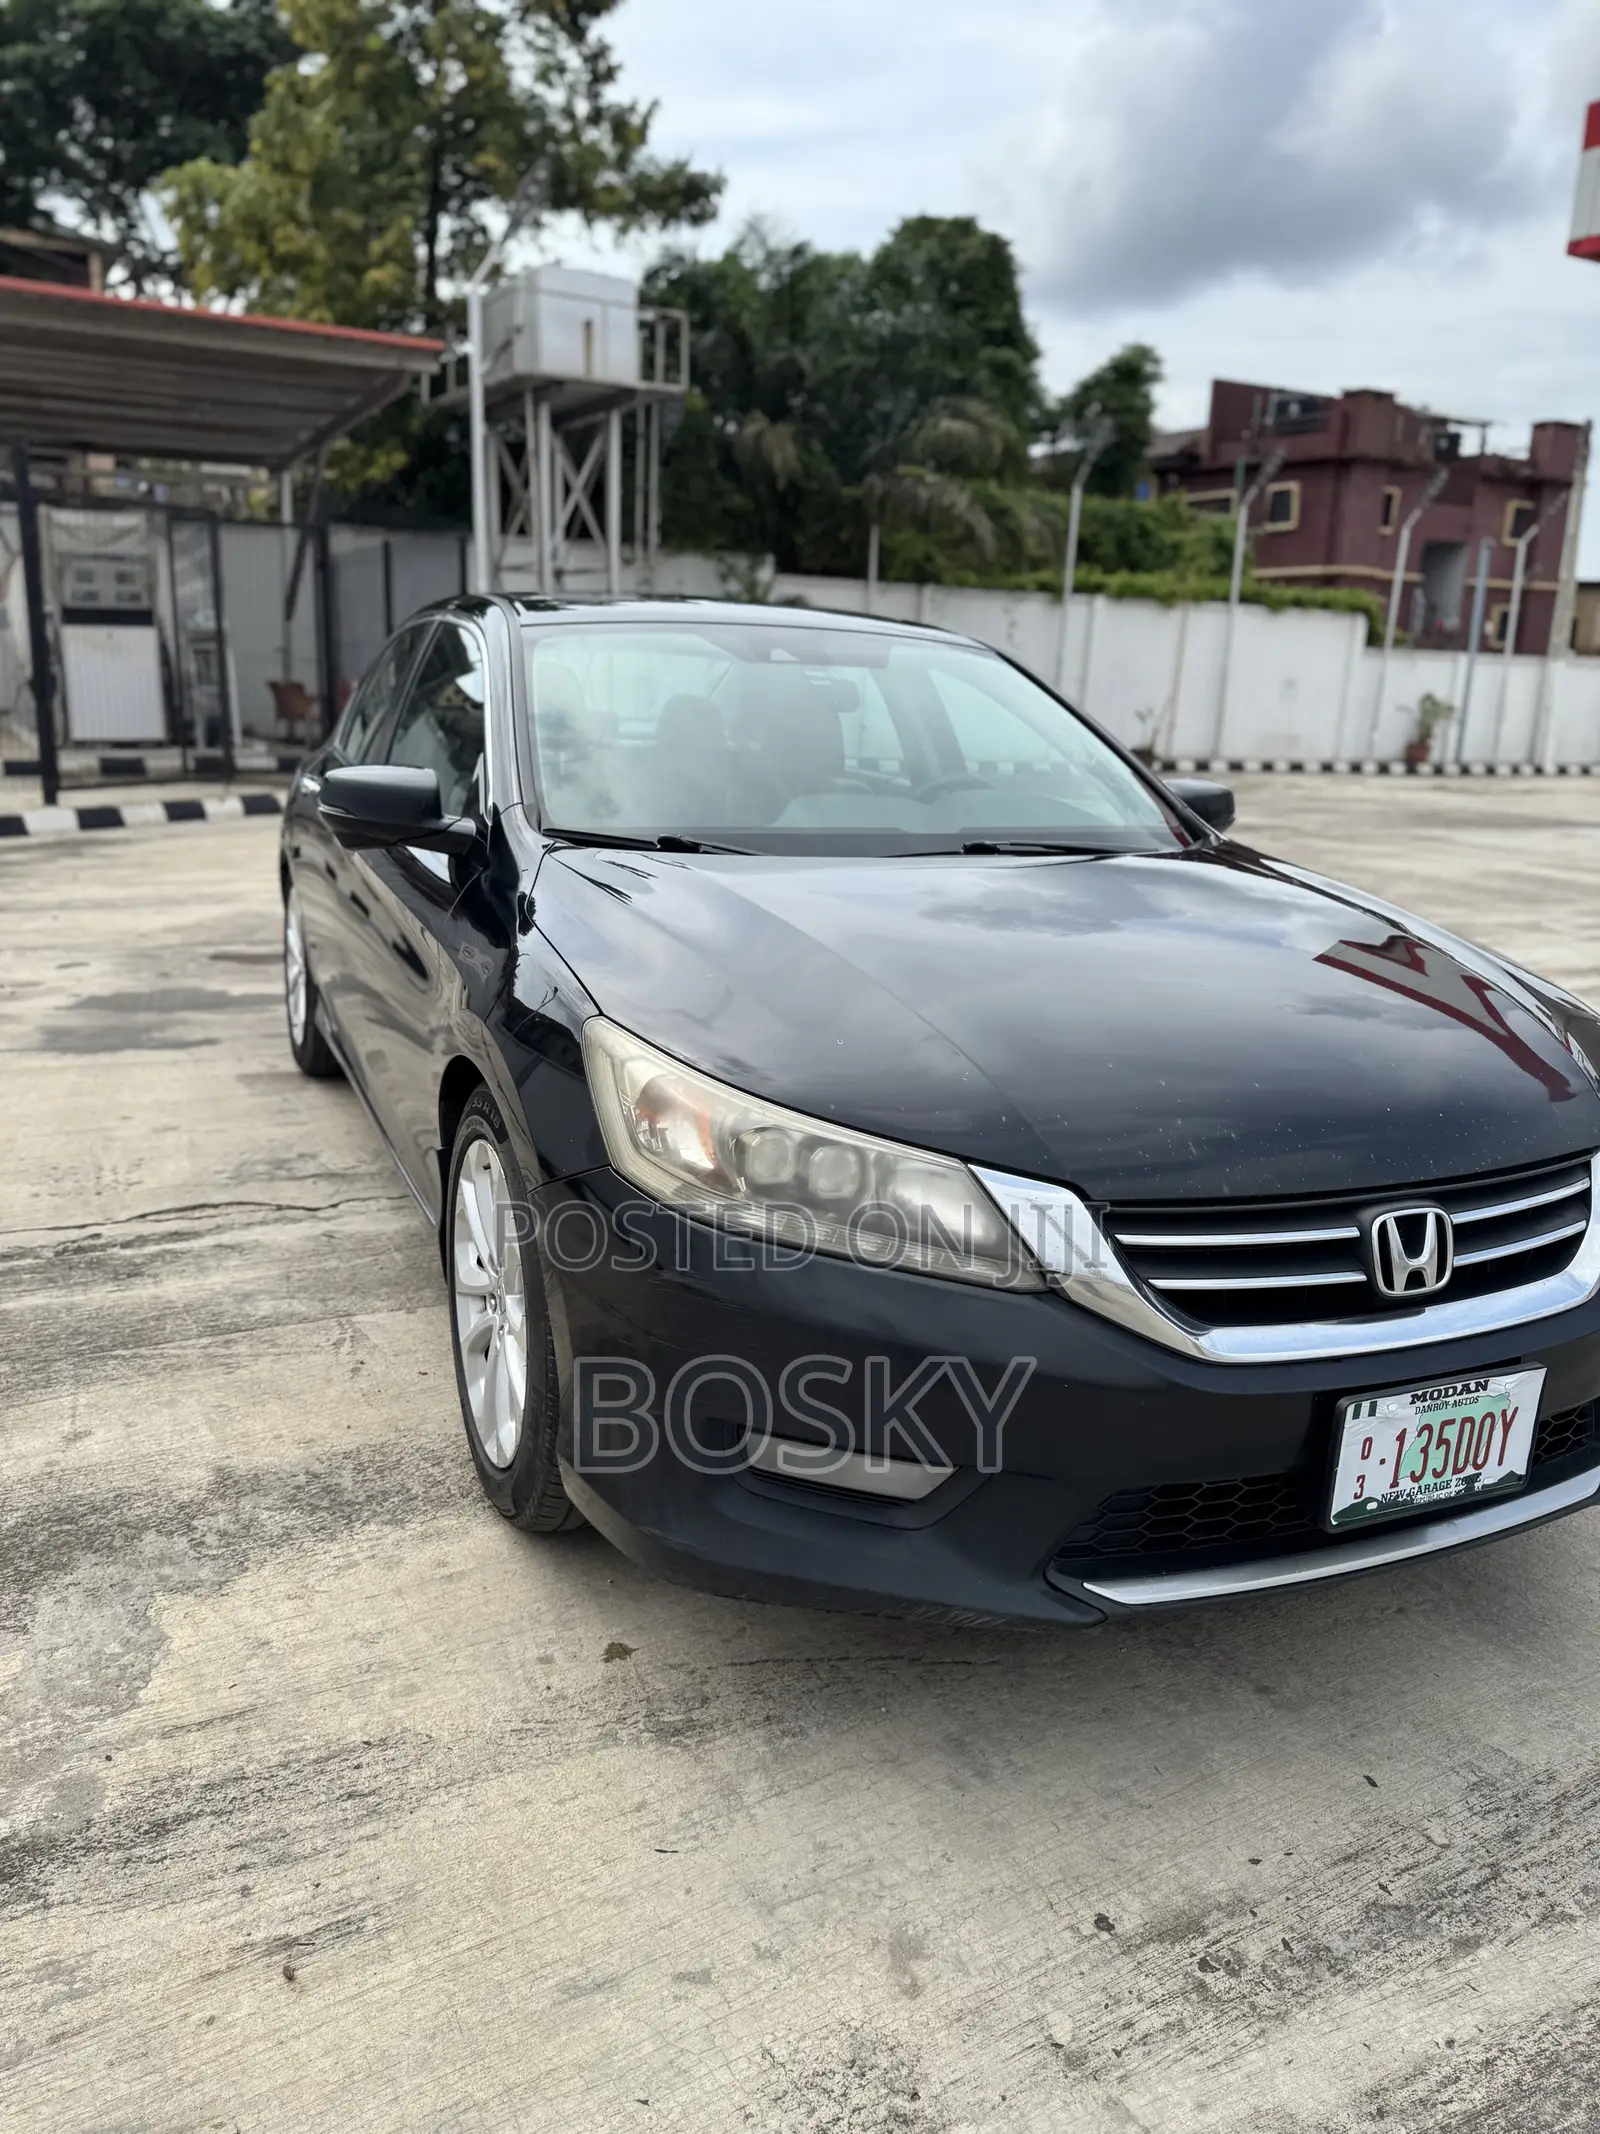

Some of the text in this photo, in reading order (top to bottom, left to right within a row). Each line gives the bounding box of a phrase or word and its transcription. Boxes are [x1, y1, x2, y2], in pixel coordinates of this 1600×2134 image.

[1409, 1379, 1490, 1405] MODAN
[1408, 1478, 1453, 1499] GARAGE
[1455, 1471, 1482, 1487] ZONE
